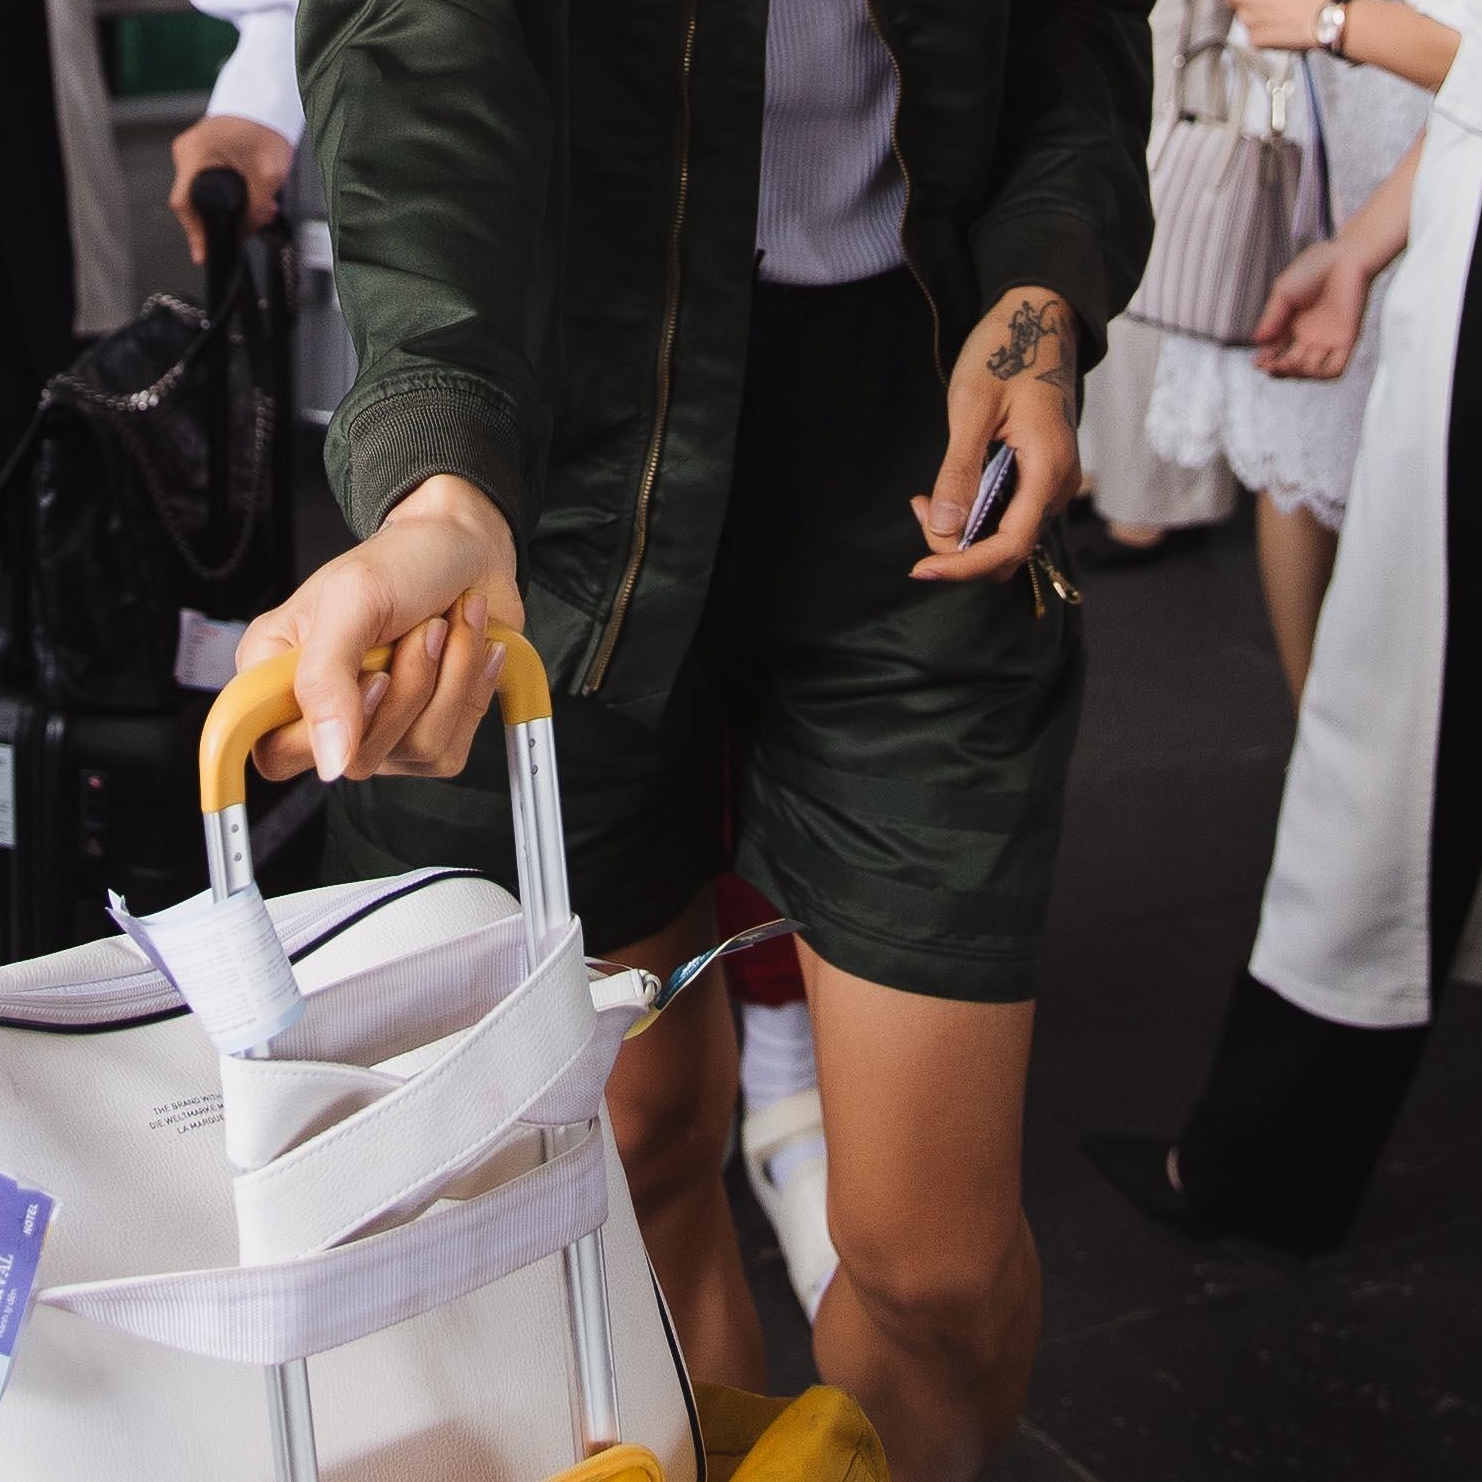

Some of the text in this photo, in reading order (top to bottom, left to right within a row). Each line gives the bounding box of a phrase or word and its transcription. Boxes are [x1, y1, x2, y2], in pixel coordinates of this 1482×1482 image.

[153, 1105, 171, 1115] THE
[171, 1097, 201, 1110] BRAND
[148, 1119, 165, 1130] DIE
[177, 1125, 190, 1135] LA
[23, 1203, 38, 1235] HOTEL
